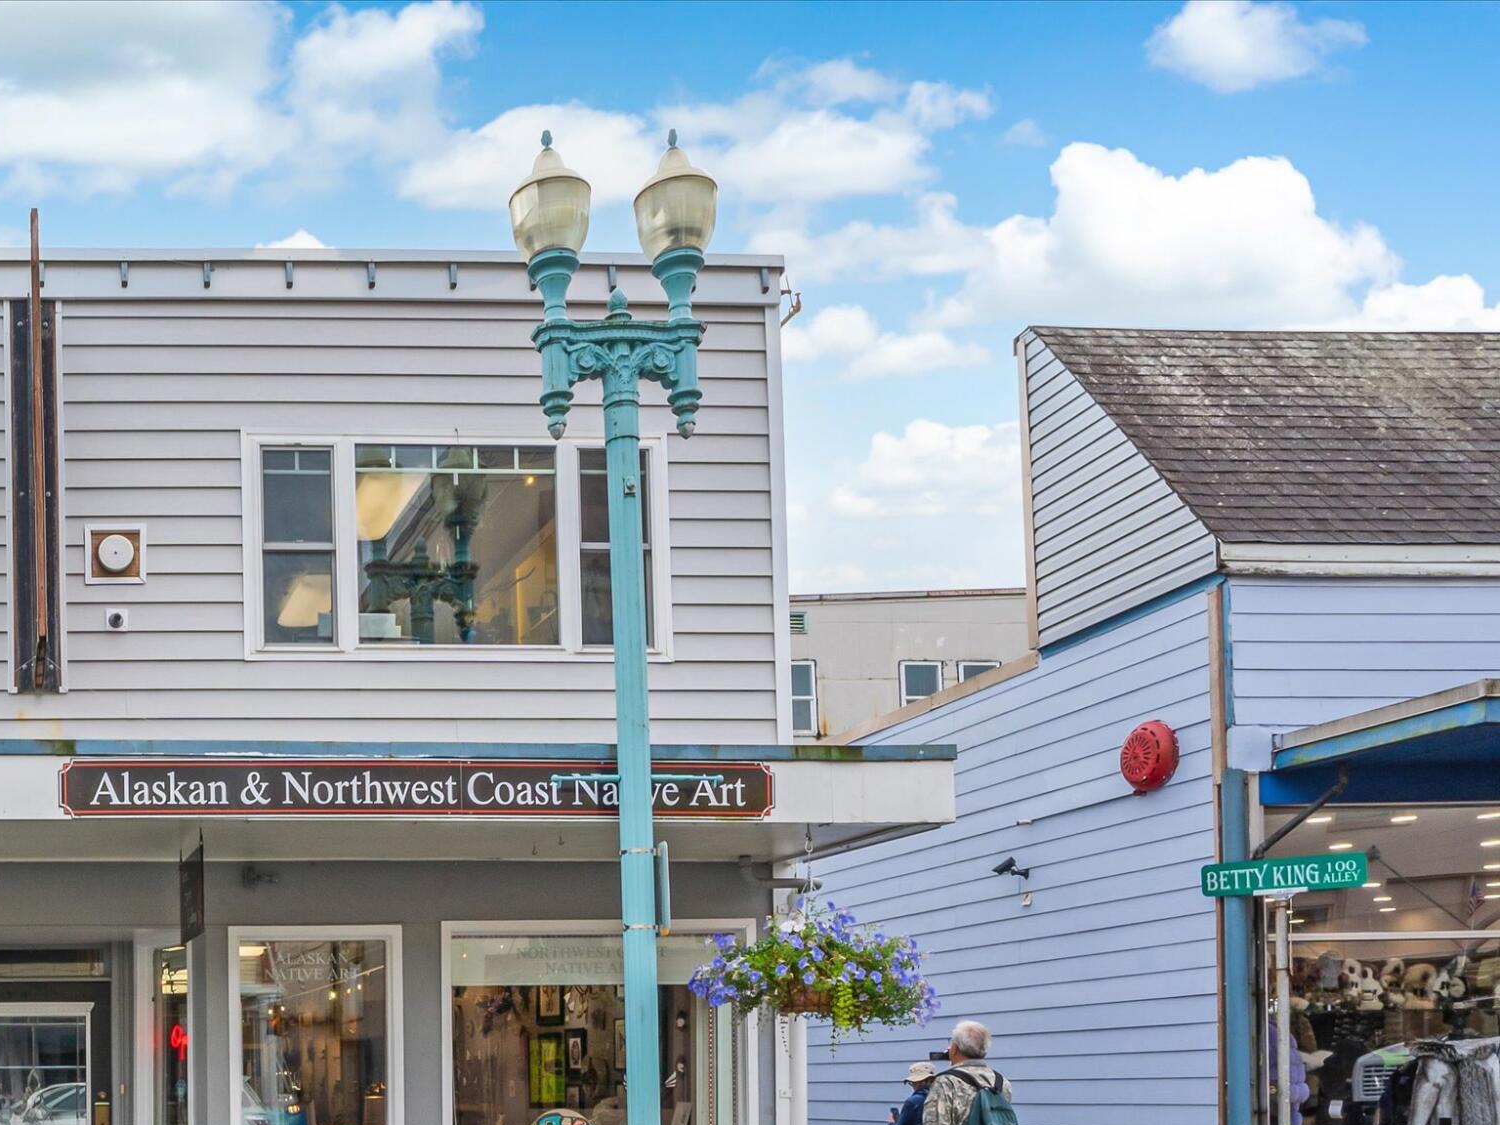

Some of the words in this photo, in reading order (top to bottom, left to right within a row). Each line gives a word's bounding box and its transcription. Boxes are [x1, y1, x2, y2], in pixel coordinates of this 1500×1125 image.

[89, 771, 230, 806] Alaskan
[240, 771, 272, 805] &
[281, 770, 458, 806] Northwest
[689, 774, 748, 808] Art
[1327, 860, 1356, 873] 100
[1206, 863, 1268, 891] BETTY
[1273, 864, 1319, 887] KING
[1323, 869, 1361, 884] ALLEY
[276, 952, 349, 966] ALASKAN
[516, 946, 614, 960] NORTHWEST
[264, 968, 322, 981] NATIVE
[327, 968, 360, 981] ART
[546, 961, 605, 975] NATIVE
